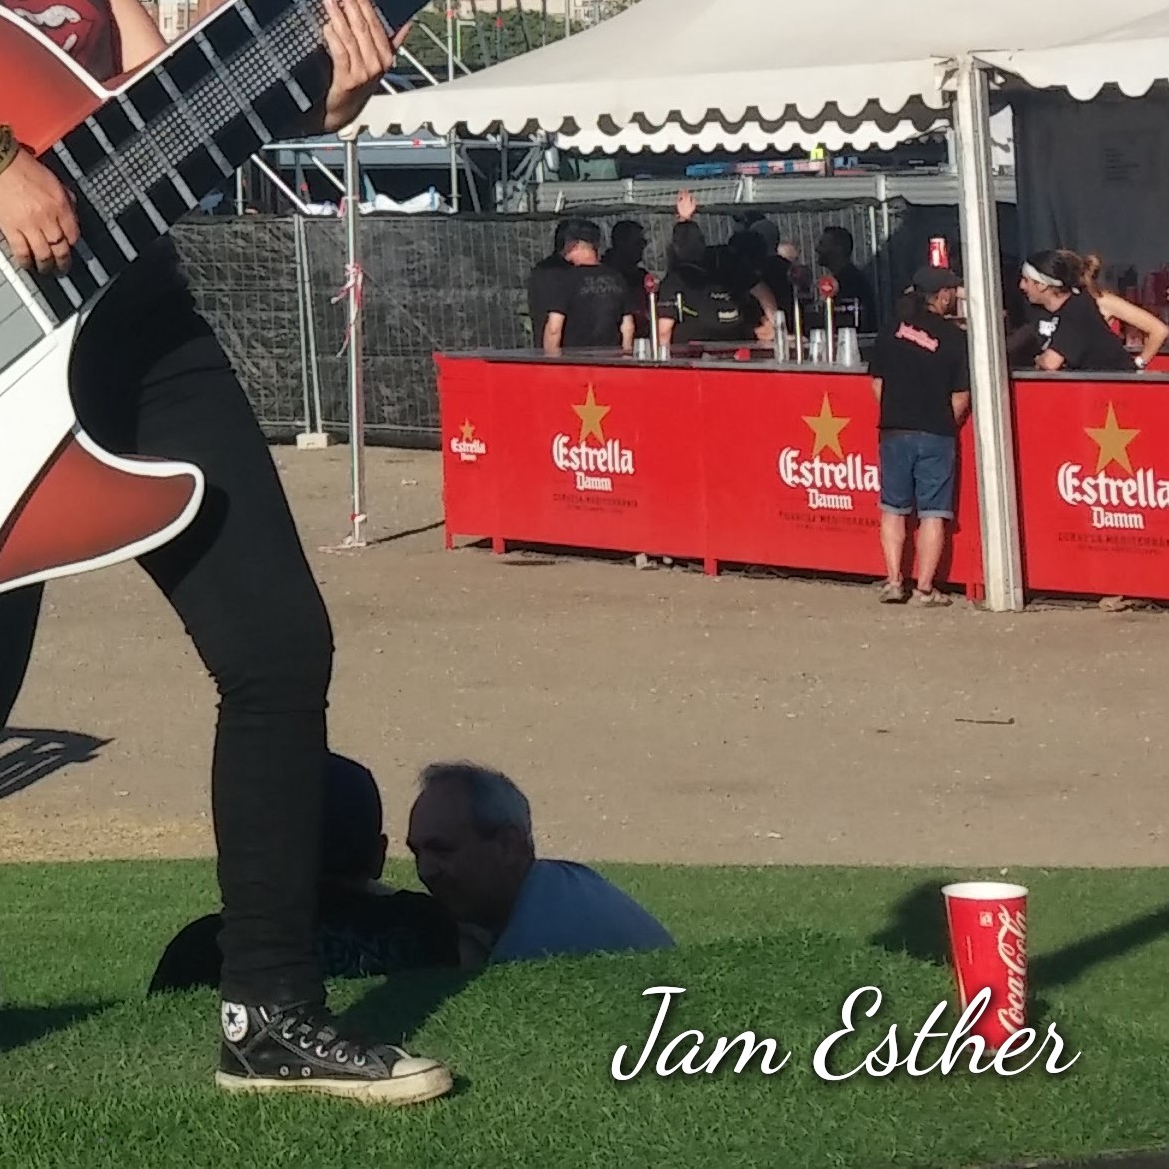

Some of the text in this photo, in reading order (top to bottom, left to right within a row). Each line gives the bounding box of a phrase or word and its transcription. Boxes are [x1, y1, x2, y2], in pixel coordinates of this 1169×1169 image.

[552, 433, 635, 475] Estrella
[779, 446, 881, 492] Estrella
[575, 472, 613, 491] Damm
[1058, 461, 1169, 509] Estrella
[807, 488, 853, 511] Damm
[1090, 506, 1145, 530] Damm
